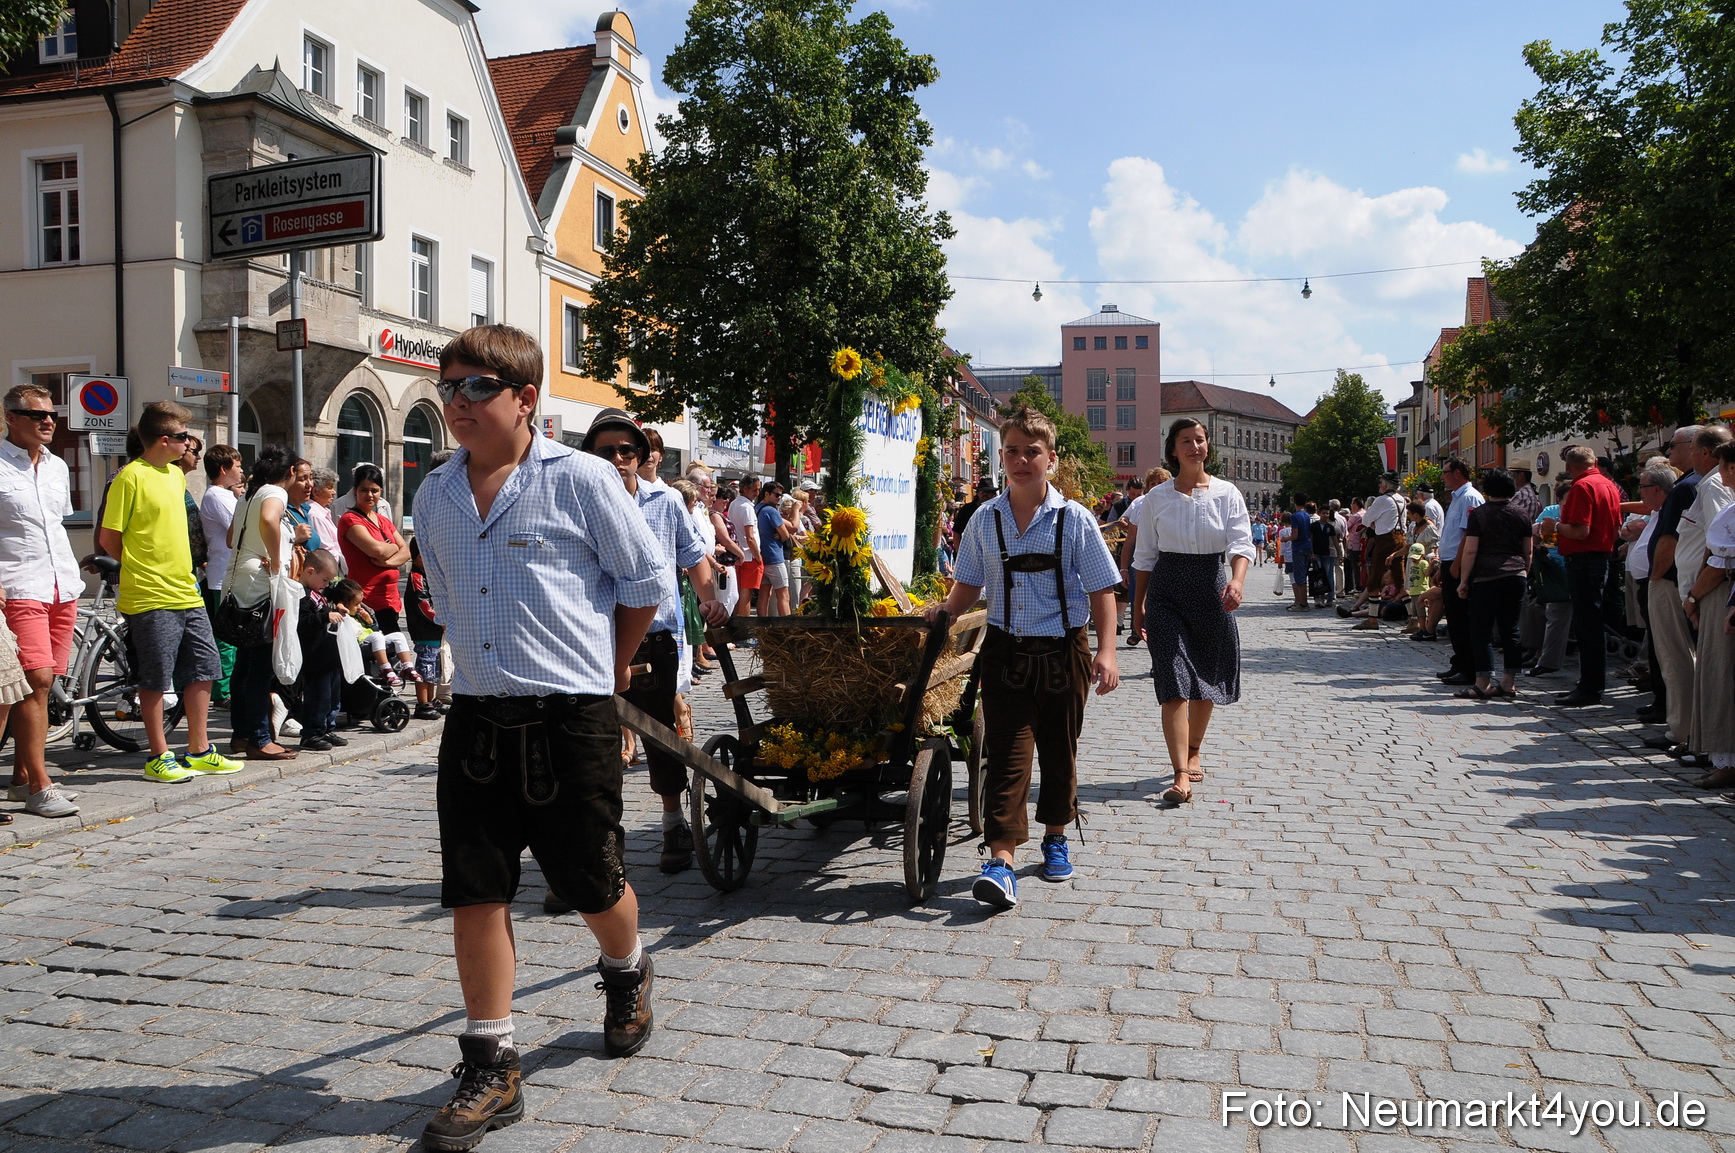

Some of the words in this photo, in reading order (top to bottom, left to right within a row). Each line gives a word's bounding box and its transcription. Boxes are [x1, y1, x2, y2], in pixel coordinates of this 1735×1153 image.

[235, 171, 342, 203] Parkleitsystem
[248, 224, 258, 241] P
[273, 211, 344, 233] Rosengasse
[84, 417, 114, 428] ZONE
